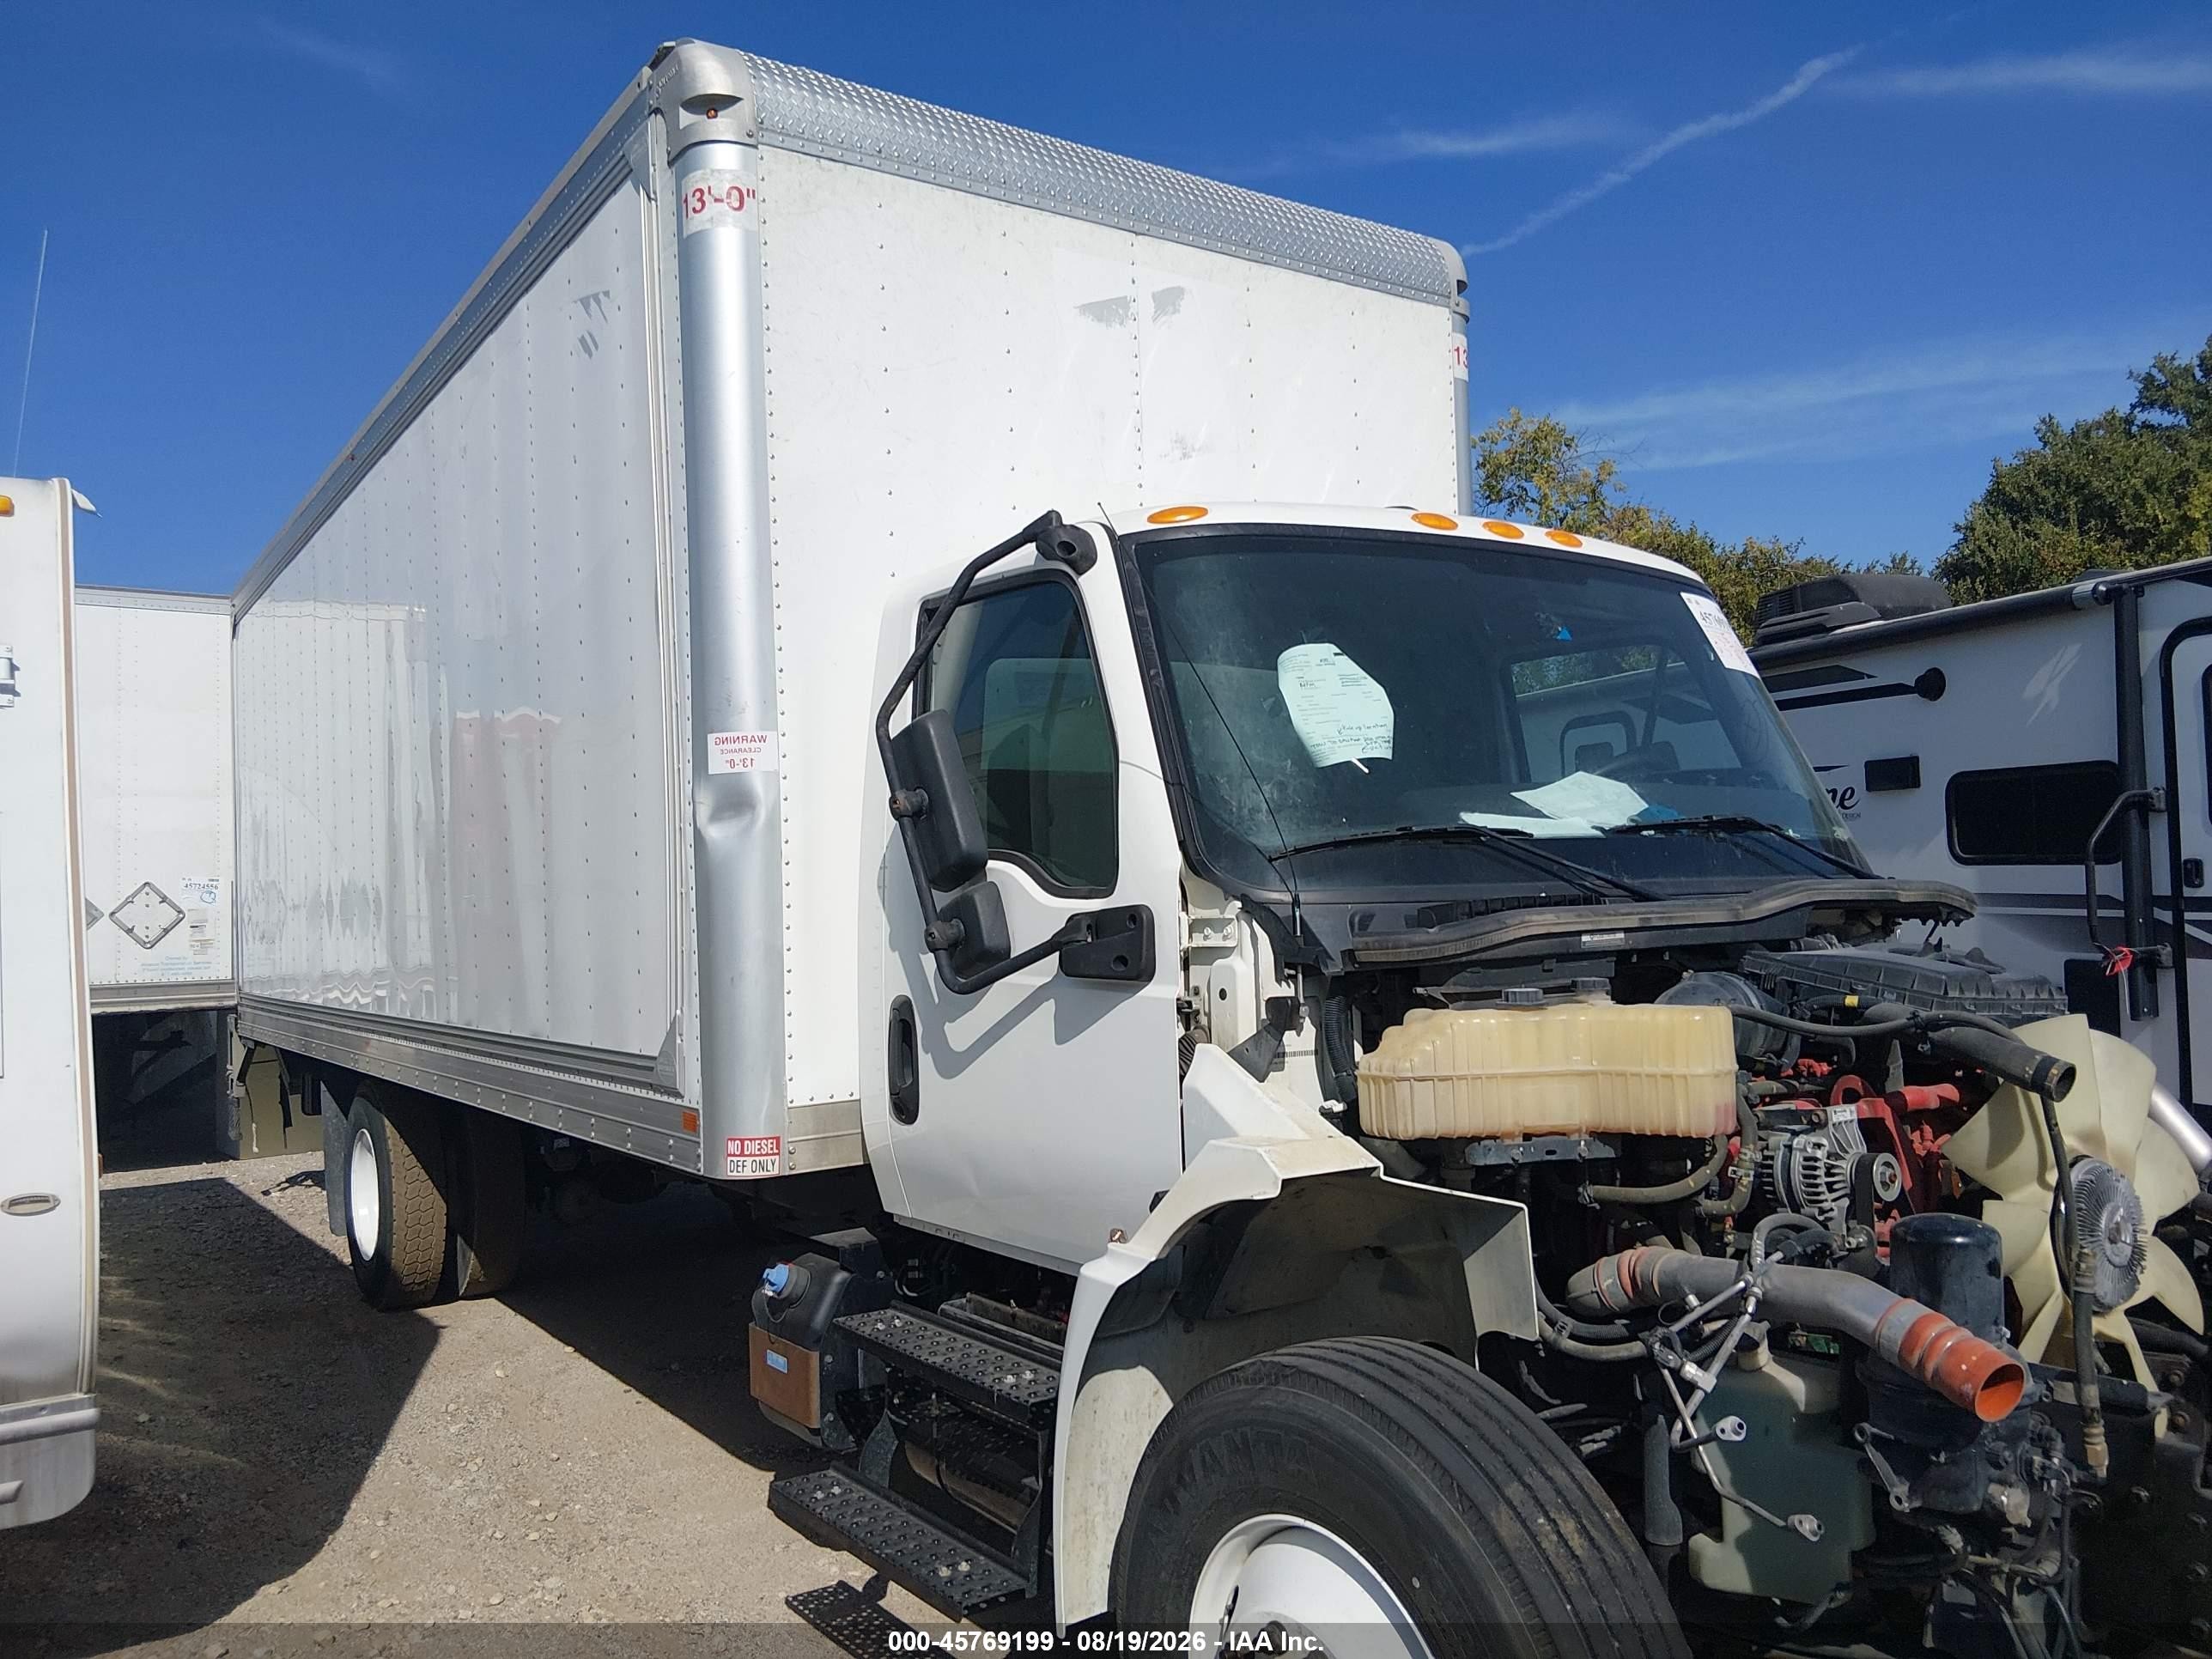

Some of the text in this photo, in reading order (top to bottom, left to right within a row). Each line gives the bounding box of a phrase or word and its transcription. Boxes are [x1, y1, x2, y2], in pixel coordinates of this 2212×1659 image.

[683, 185, 756, 219] 13'-0"
[184, 882, 219, 891] 45724556
[727, 1139, 779, 1155] NO DIESEL
[729, 1158, 776, 1174] DEF ONLY
